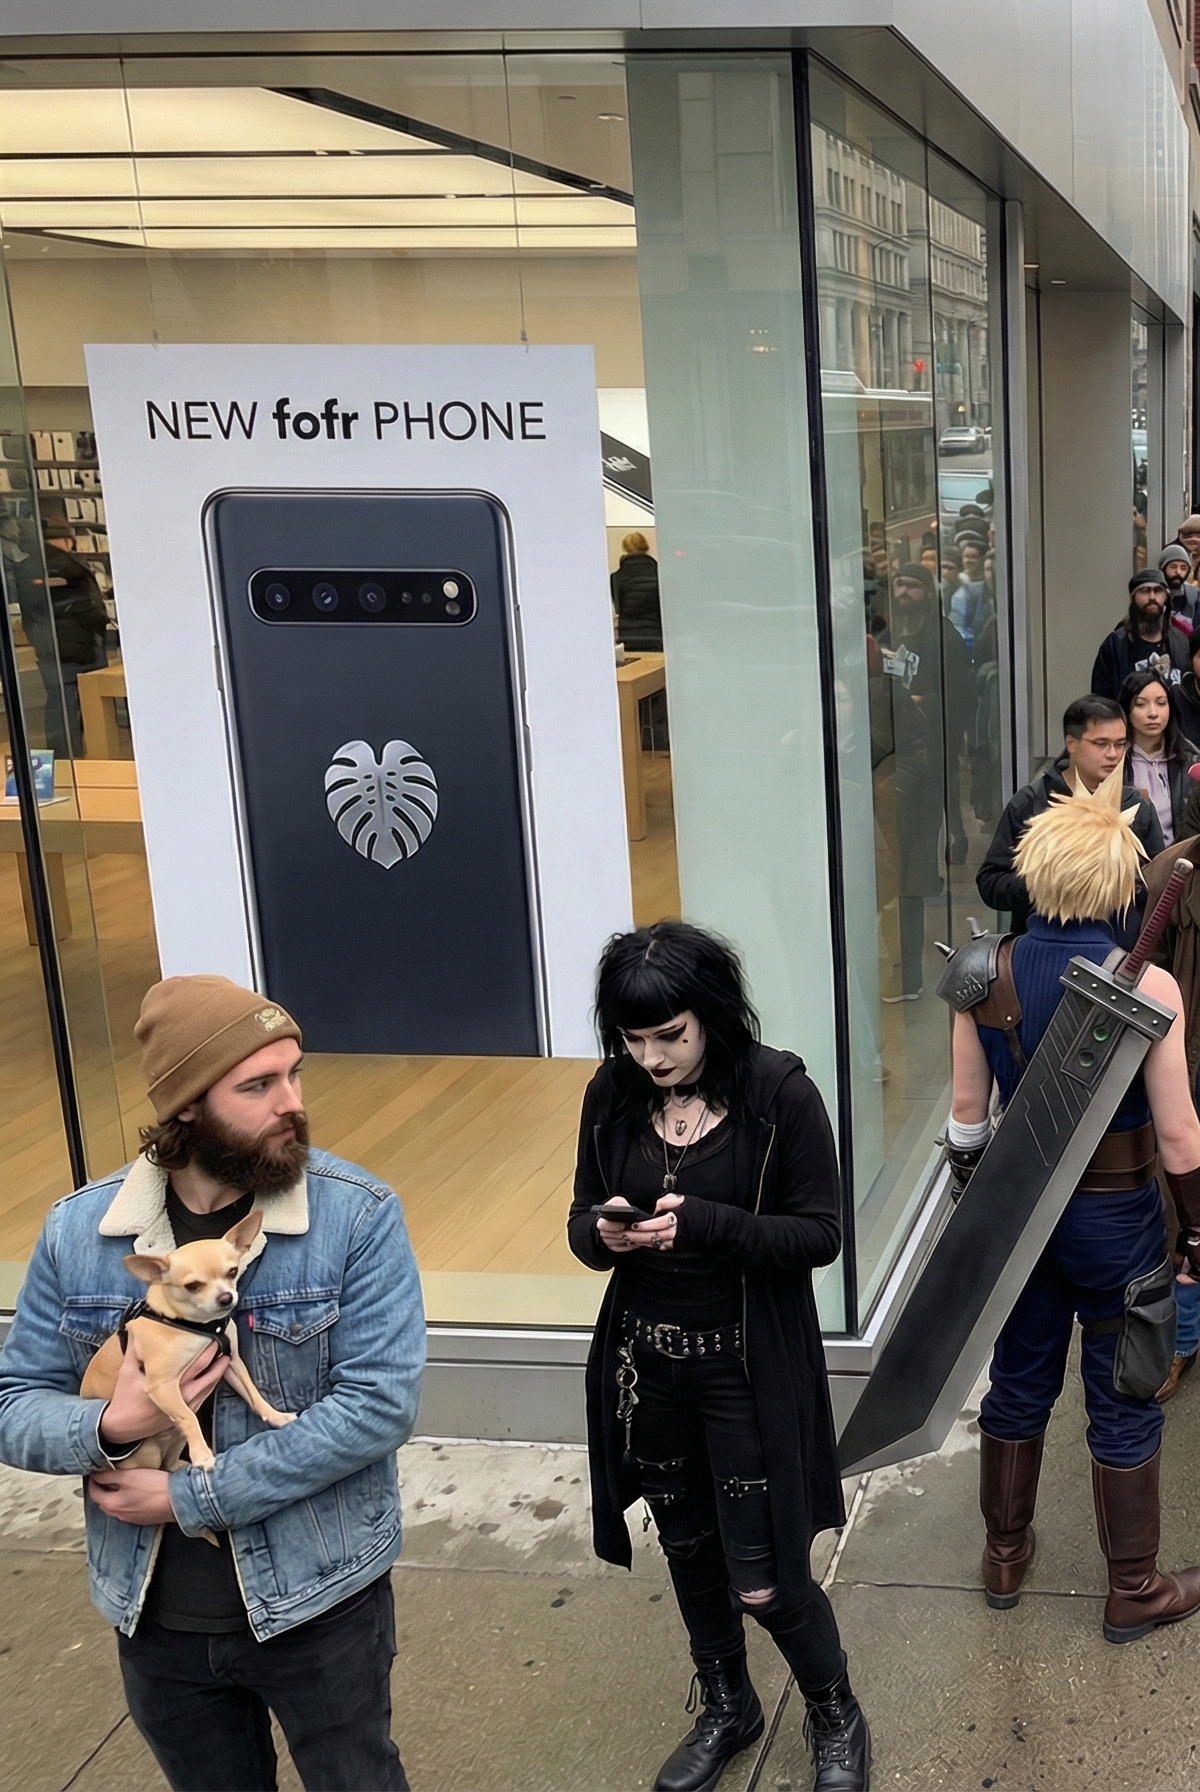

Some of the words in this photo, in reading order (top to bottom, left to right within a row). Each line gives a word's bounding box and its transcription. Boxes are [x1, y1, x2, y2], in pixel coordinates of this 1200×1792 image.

[146, 401, 257, 440] NEW
[272, 397, 359, 440] fofr
[375, 401, 547, 440] PHONE
